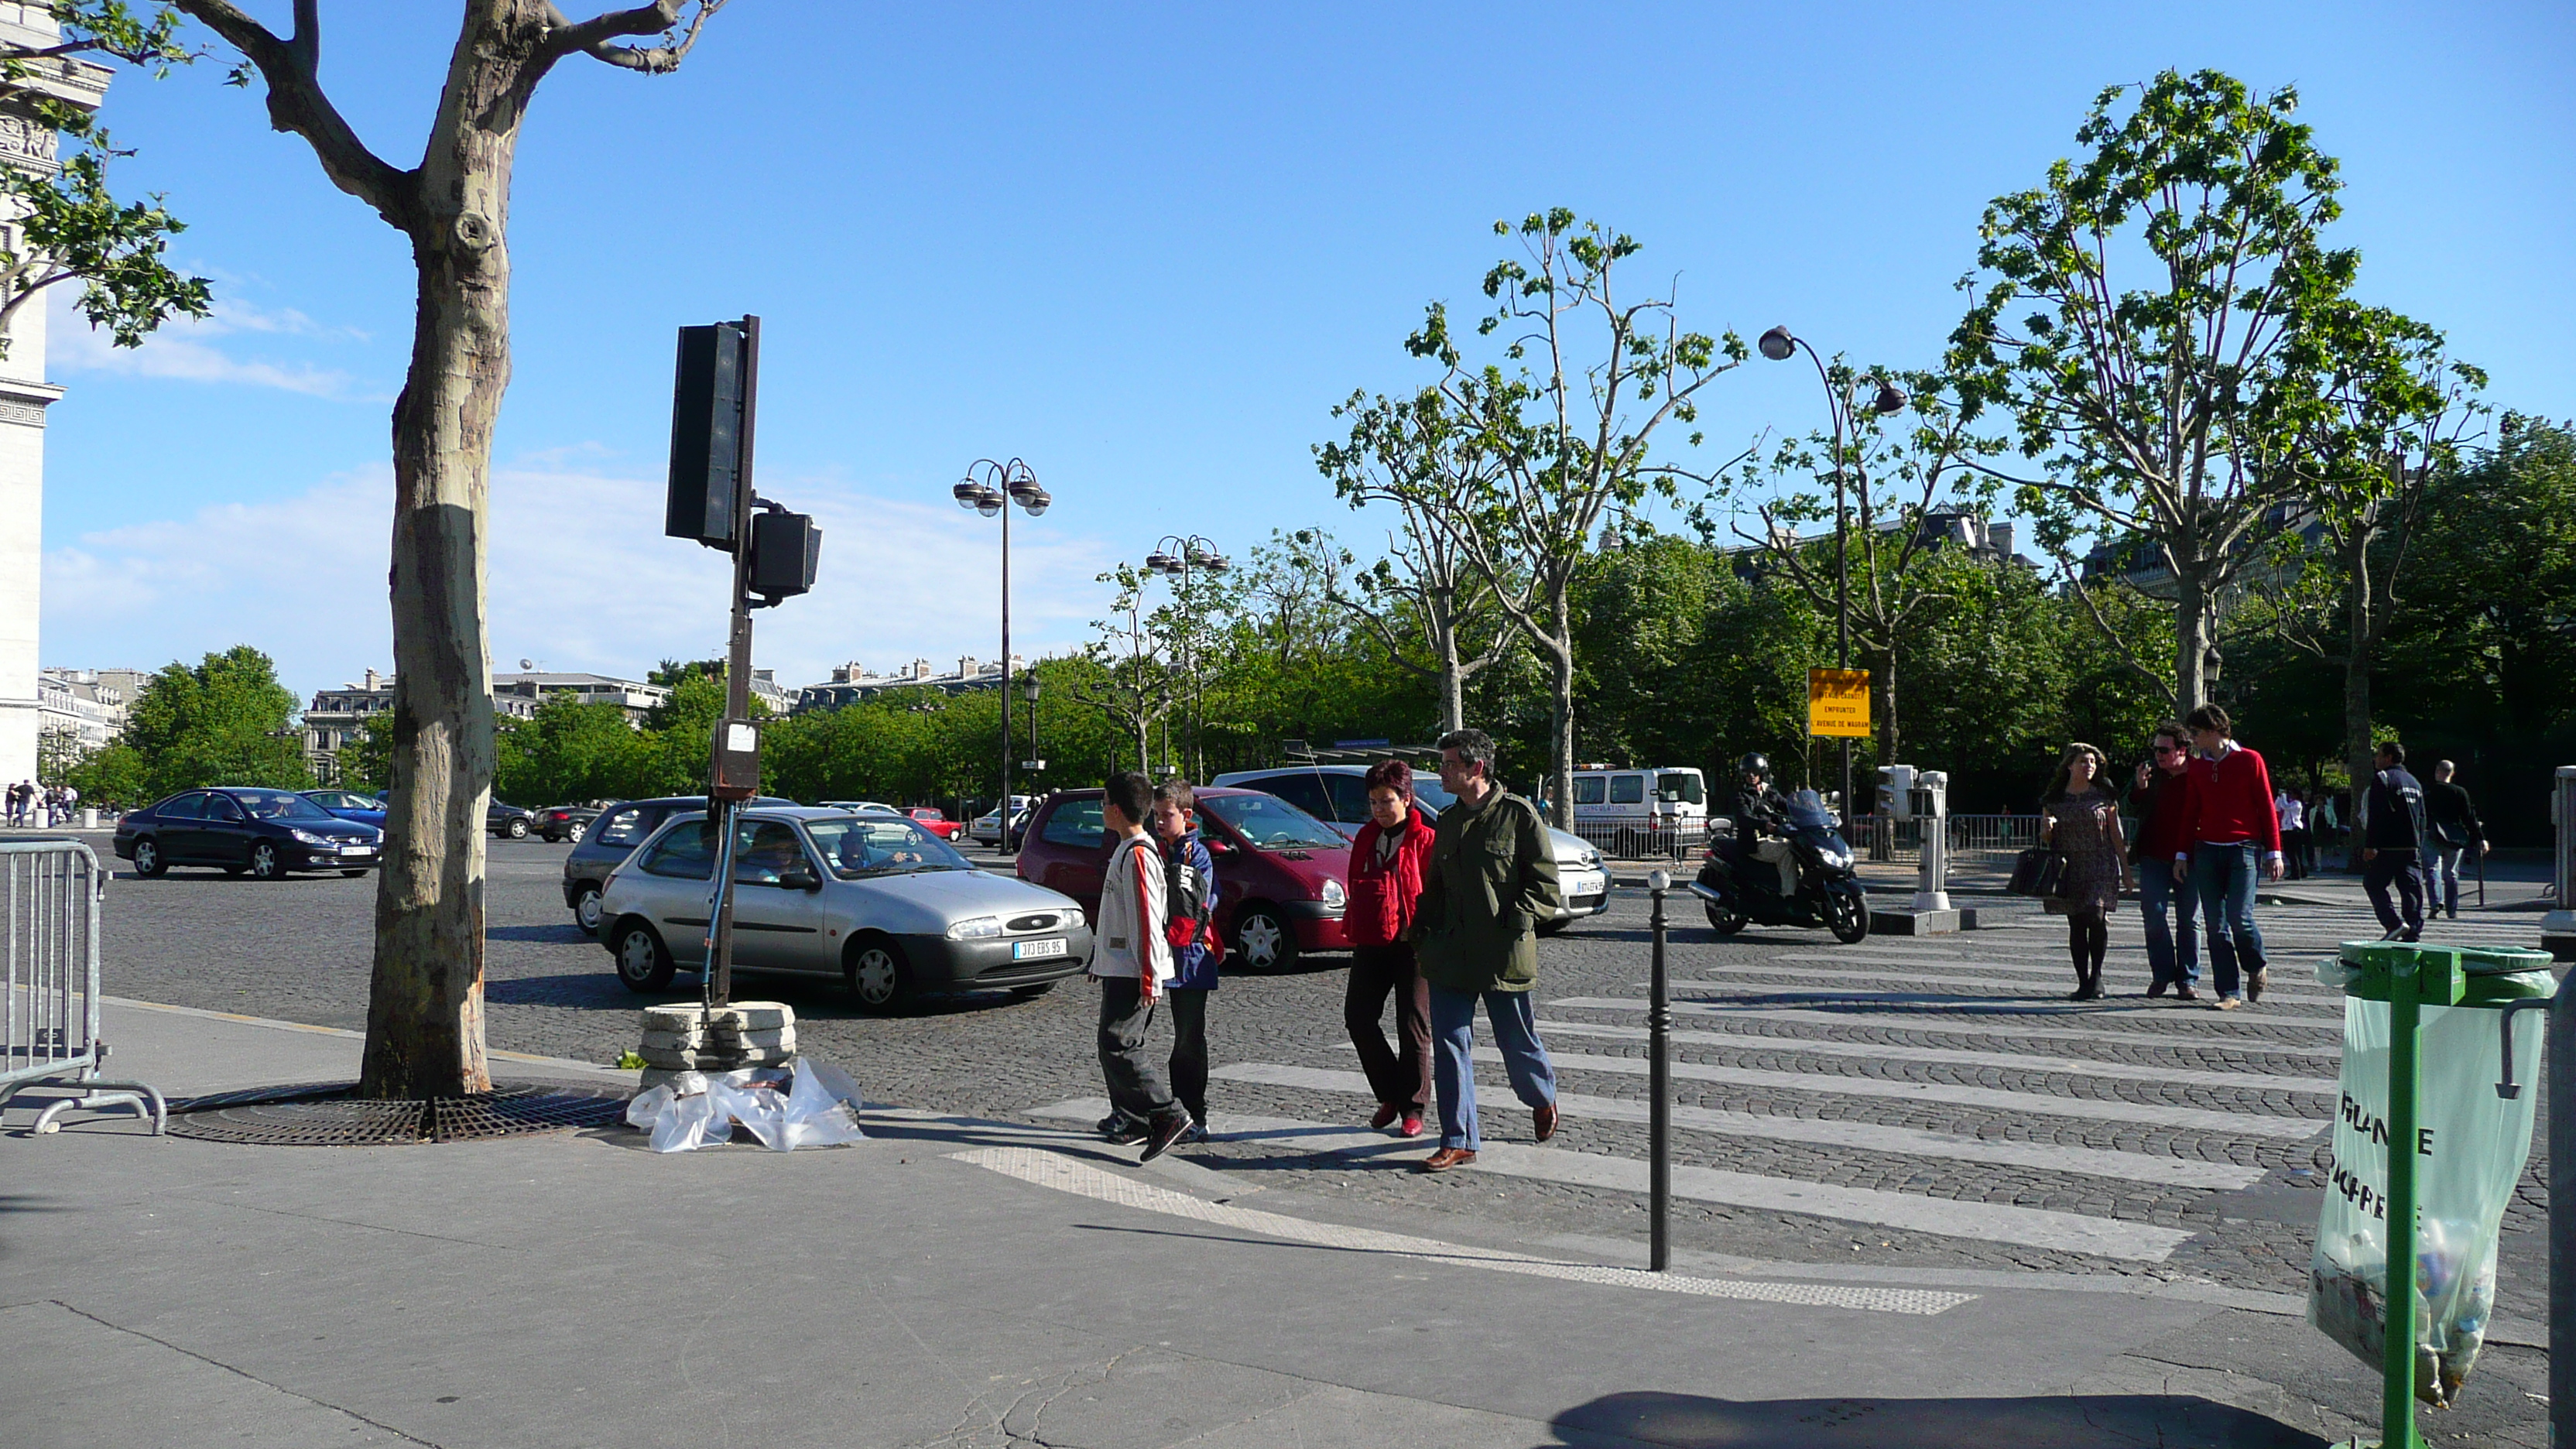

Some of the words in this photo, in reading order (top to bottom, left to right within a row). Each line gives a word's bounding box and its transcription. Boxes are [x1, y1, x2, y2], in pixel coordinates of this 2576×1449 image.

[1023, 943, 1035, 956] 373
[1037, 941, 1050, 954] EBS
[1052, 940, 1060, 953] 95
